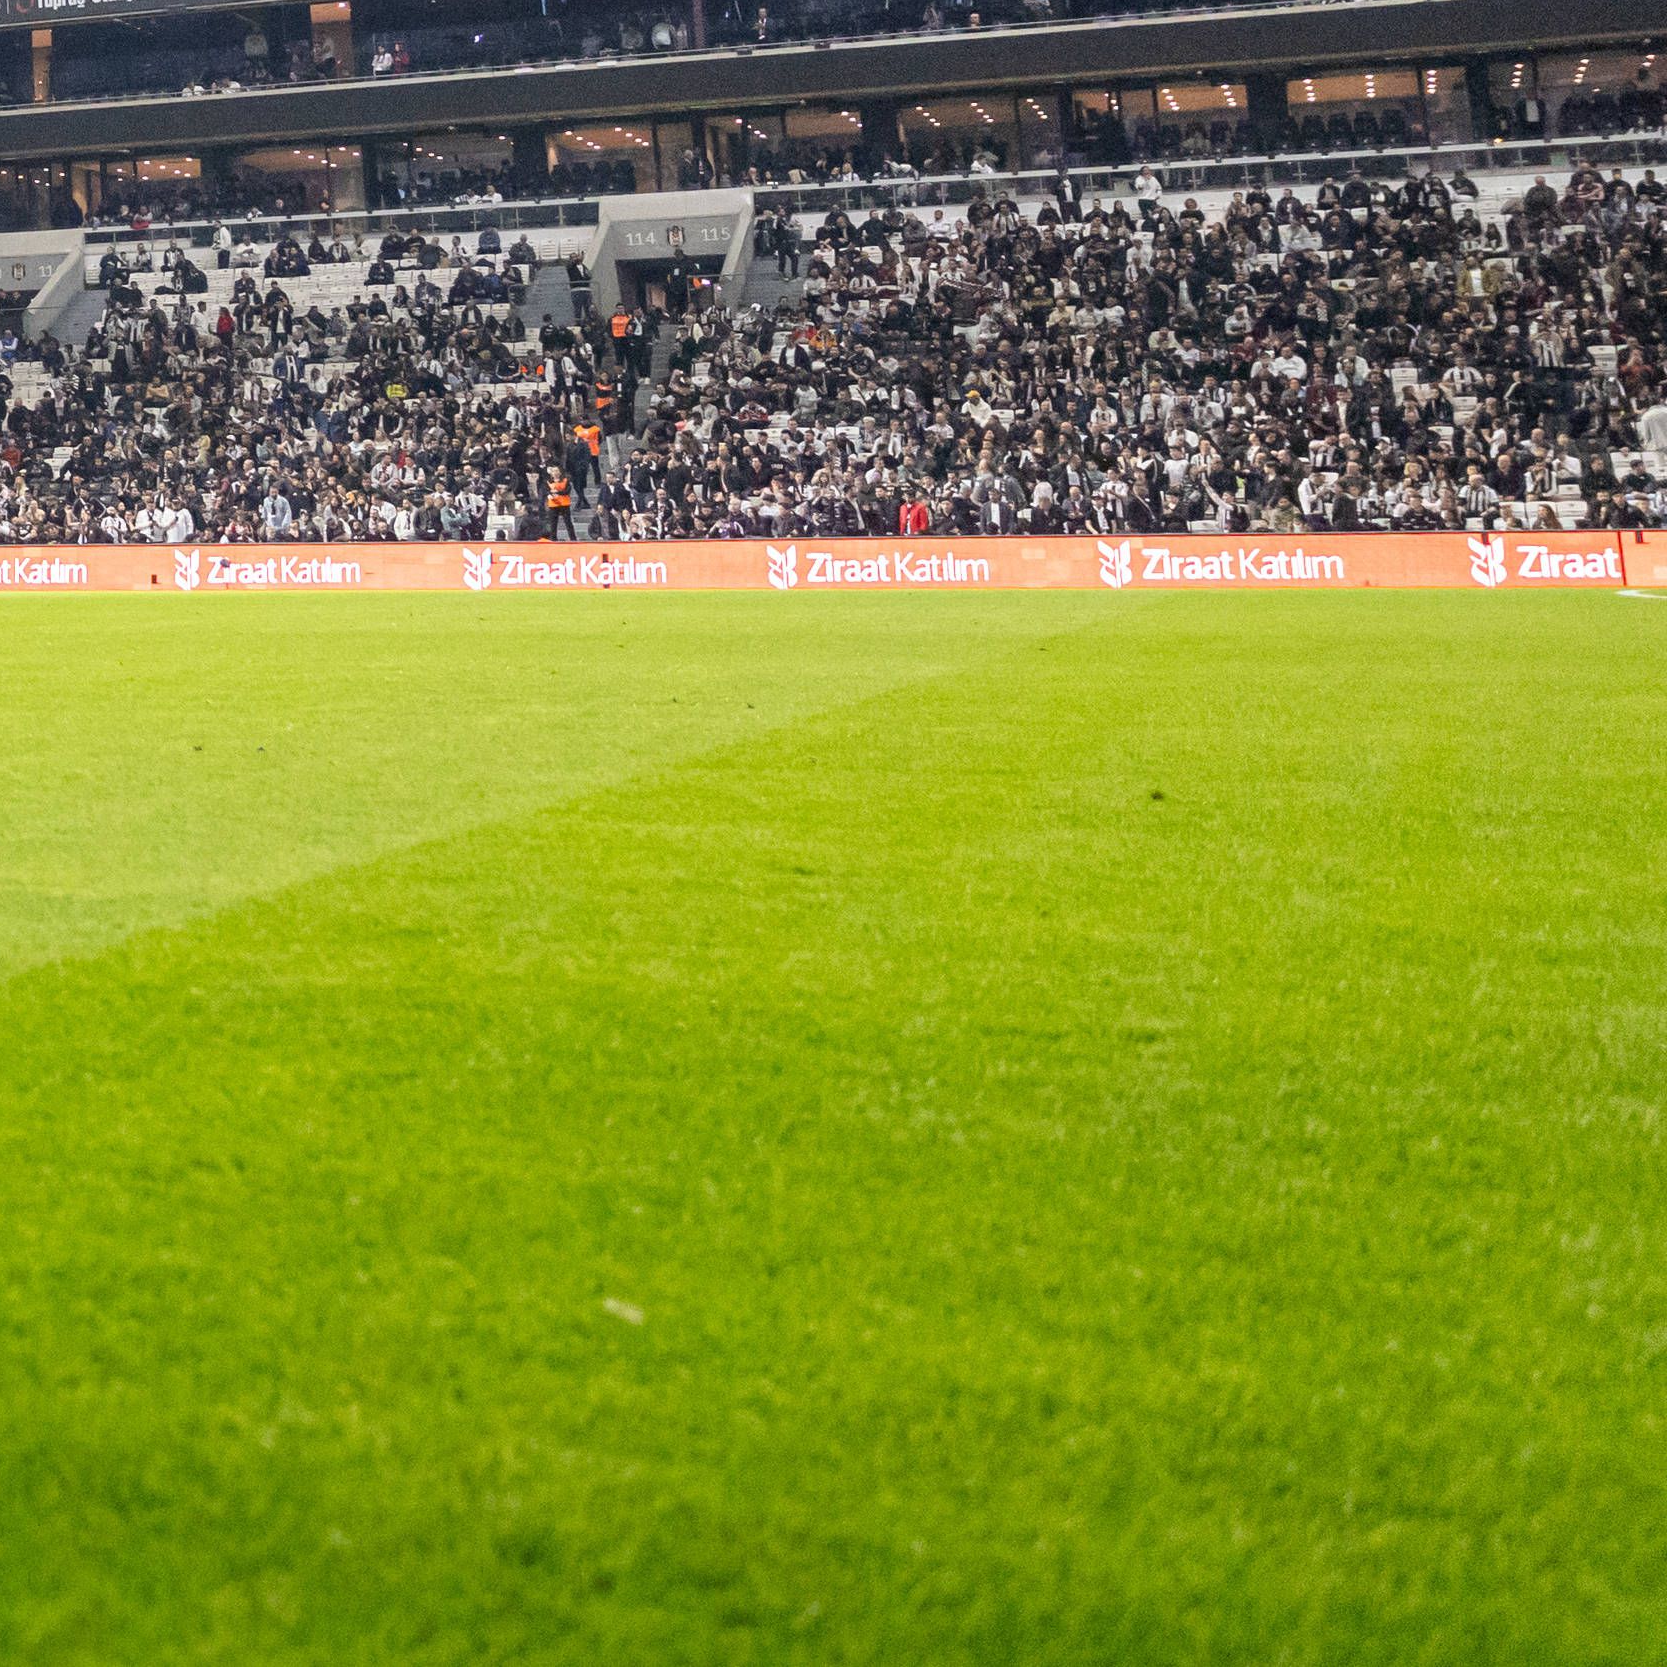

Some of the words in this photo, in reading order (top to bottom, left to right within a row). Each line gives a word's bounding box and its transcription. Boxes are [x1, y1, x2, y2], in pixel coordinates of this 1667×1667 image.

[626, 231, 655, 246] 114
[701, 226, 731, 242] 115
[38, 264, 59, 278] 11
[14, 557, 88, 584] Katılım
[207, 556, 278, 584] Ziraat
[280, 556, 361, 584] Katılım
[499, 555, 577, 585] Ziraat
[579, 556, 667, 585] Katılım
[806, 552, 891, 583] Ziraat
[894, 552, 990, 582] Katılım
[1141, 548, 1236, 580] Ziraat
[1238, 548, 1345, 580] Katılım
[1516, 545, 1622, 579] Ziraat
